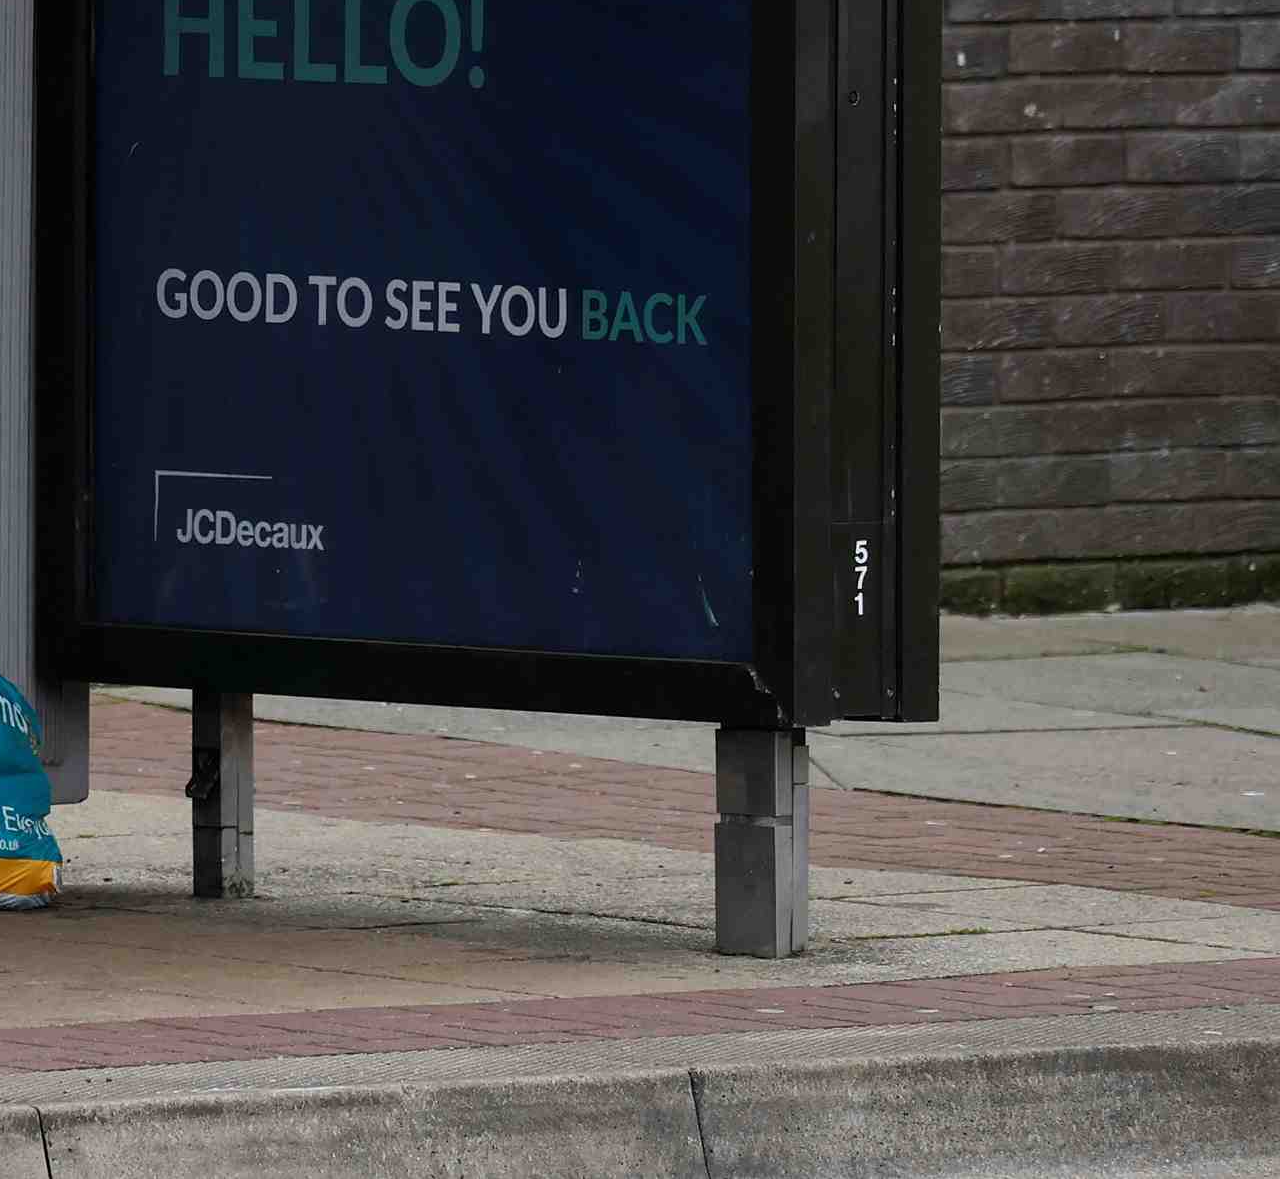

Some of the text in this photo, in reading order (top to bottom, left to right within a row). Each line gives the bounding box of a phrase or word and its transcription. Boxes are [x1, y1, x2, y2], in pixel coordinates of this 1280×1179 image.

[156, 268, 708, 346] GOOD TO SEE YOU BACK
[176, 508, 325, 551] JCDecaux
